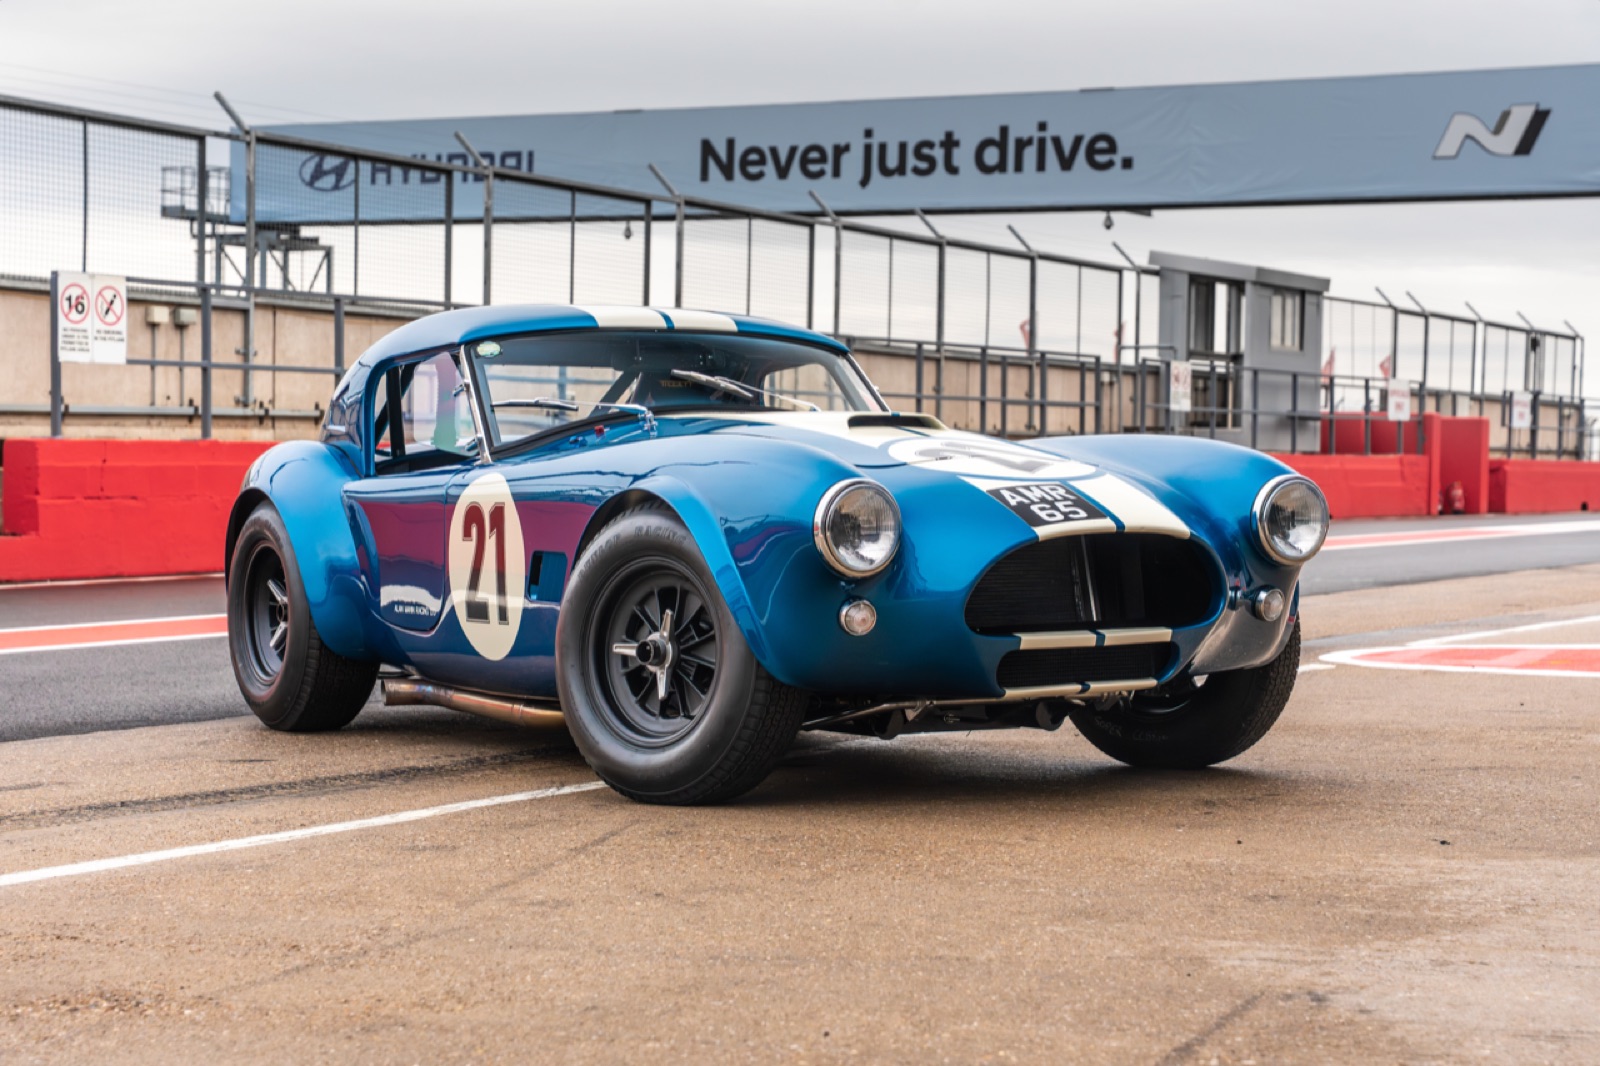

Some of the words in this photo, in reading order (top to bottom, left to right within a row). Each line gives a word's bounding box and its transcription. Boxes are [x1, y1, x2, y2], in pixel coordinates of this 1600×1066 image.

[700, 137, 850, 183] Never
[859, 127, 961, 189] just
[974, 121, 1135, 175] drive.
[65, 294, 85, 315] 16
[1000, 485, 1077, 506] AMR
[1030, 500, 1088, 522] 65
[462, 501, 509, 625] 21
